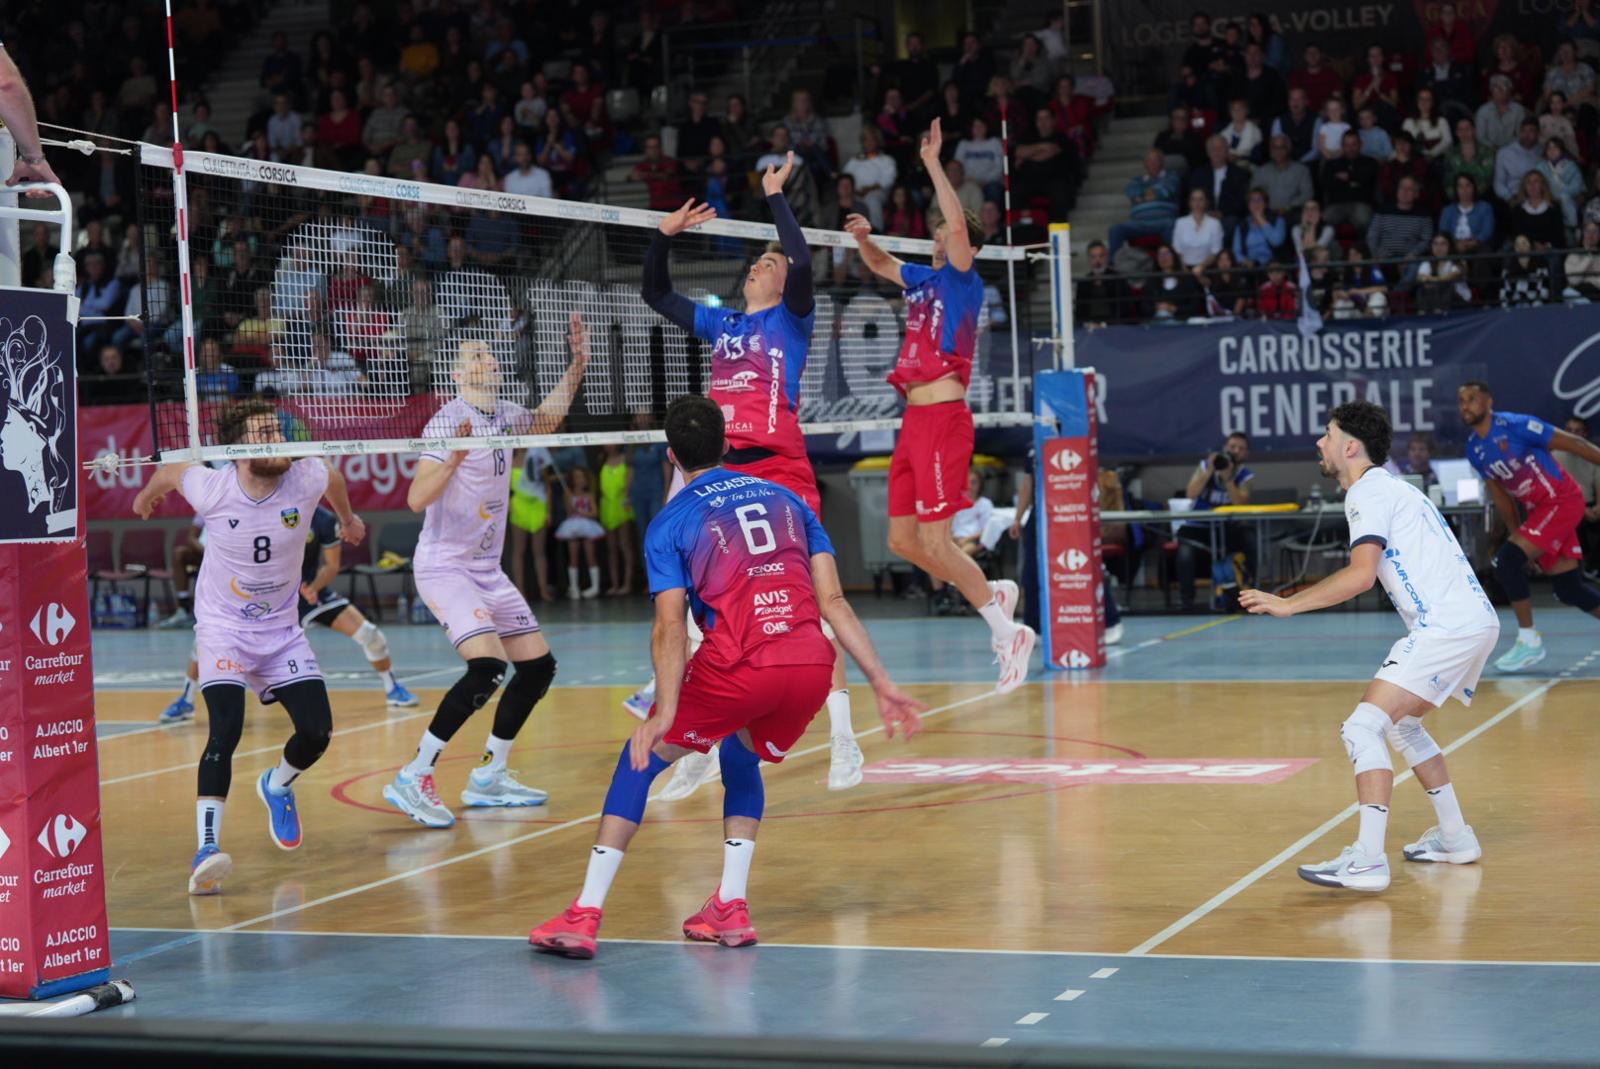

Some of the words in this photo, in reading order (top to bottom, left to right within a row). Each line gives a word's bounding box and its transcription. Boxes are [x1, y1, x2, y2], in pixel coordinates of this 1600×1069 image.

[259, 165, 297, 183] CORSICA
[396, 183, 420, 199] CORSE
[498, 197, 527, 211] CORSICA
[722, 333, 745, 360] 13
[1219, 328, 1433, 375] CARROSSERIE
[96, 435, 143, 489] du
[493, 448, 506, 477] 18
[735, 503, 777, 556] 6
[253, 535, 271, 563] 8
[754, 589, 789, 606] AVIS
[25, 651, 84, 671] Carrefour
[288, 659, 299, 674] 8
[34, 669, 76, 686] market
[35, 719, 84, 738] AJACCIO
[33, 742, 71, 759] Albert
[72, 740, 89, 754] 1er
[33, 862, 95, 885] Carrefour
[43, 879, 87, 900] market
[46, 925, 97, 948] AJACCIO
[8, 959, 25, 973] 1er
[43, 949, 82, 969] Albert
[84, 946, 102, 961] 1er
